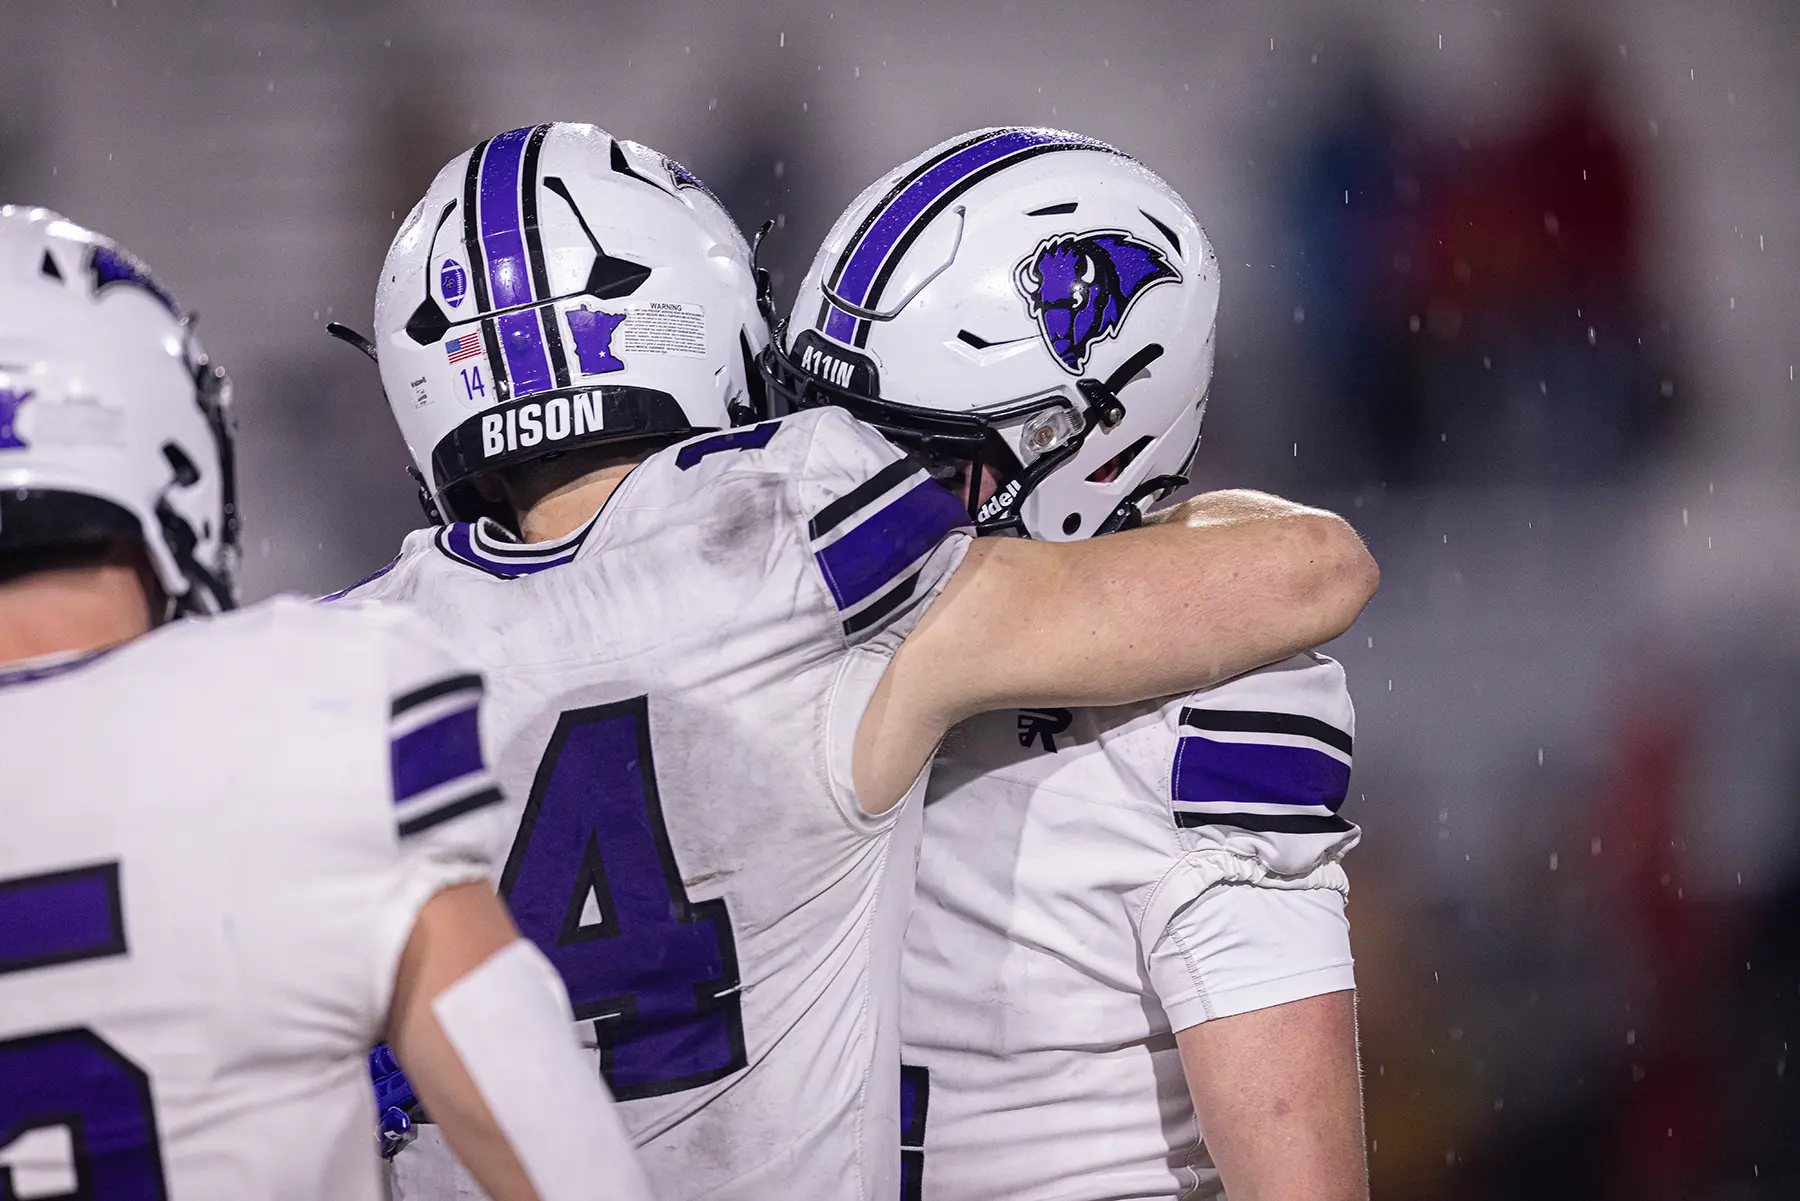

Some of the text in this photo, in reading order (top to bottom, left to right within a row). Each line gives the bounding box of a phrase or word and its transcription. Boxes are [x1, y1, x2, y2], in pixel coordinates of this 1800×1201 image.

[650, 303, 682, 312] WARNING
[460, 365, 485, 401] 14
[801, 345, 855, 389] A11IN
[482, 391, 604, 458] BISON
[977, 479, 1022, 523] ddell
[497, 693, 749, 1103] 4
